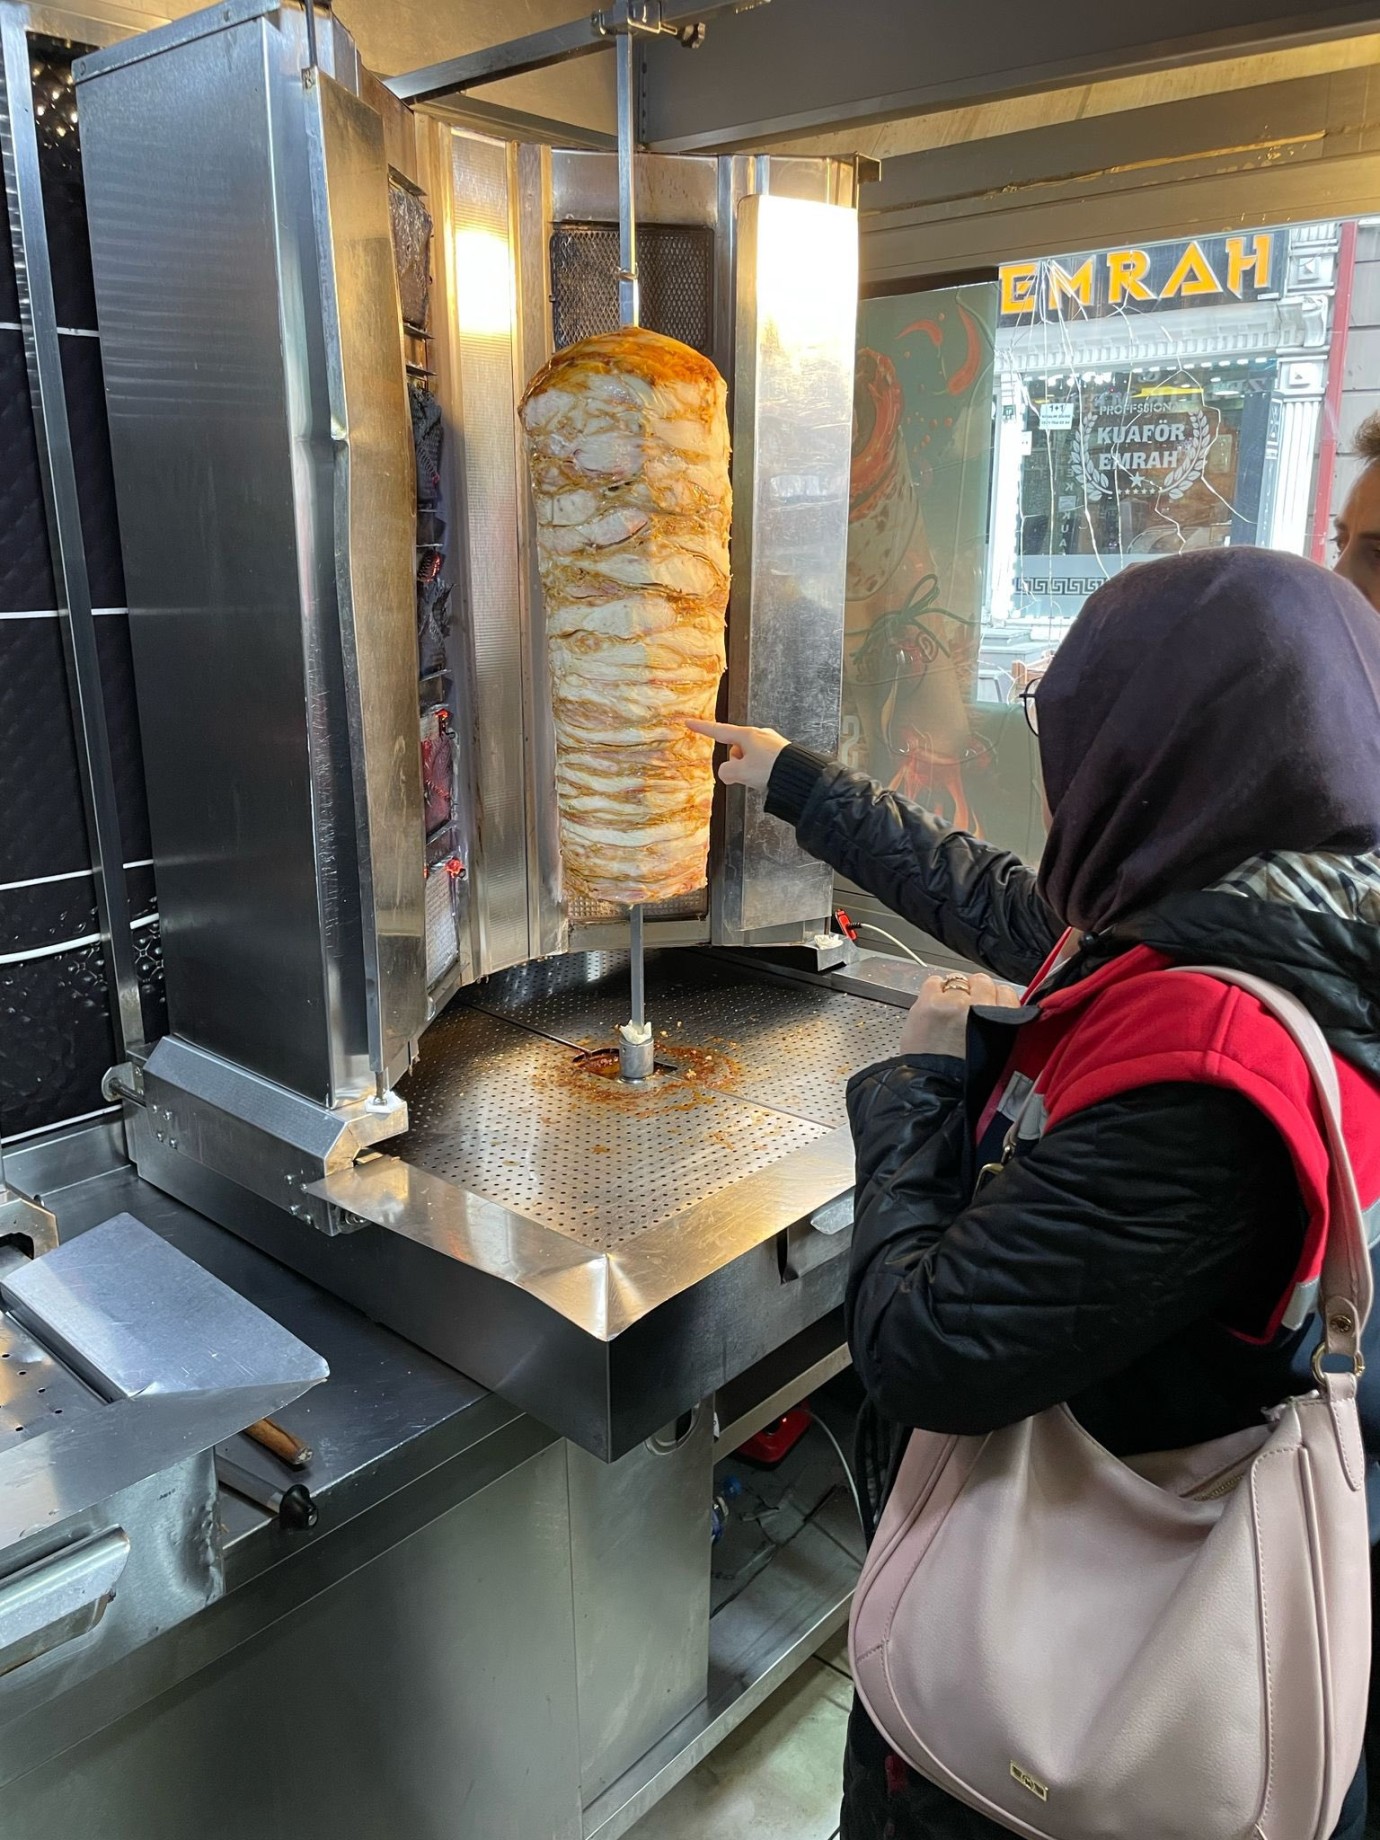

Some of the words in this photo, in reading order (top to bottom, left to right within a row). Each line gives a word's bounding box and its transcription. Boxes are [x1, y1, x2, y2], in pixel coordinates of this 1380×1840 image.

[998, 235, 1271, 315] EMRAH
[1097, 419, 1186, 444] KUAFÖR
[1098, 450, 1179, 470] EMRAH
